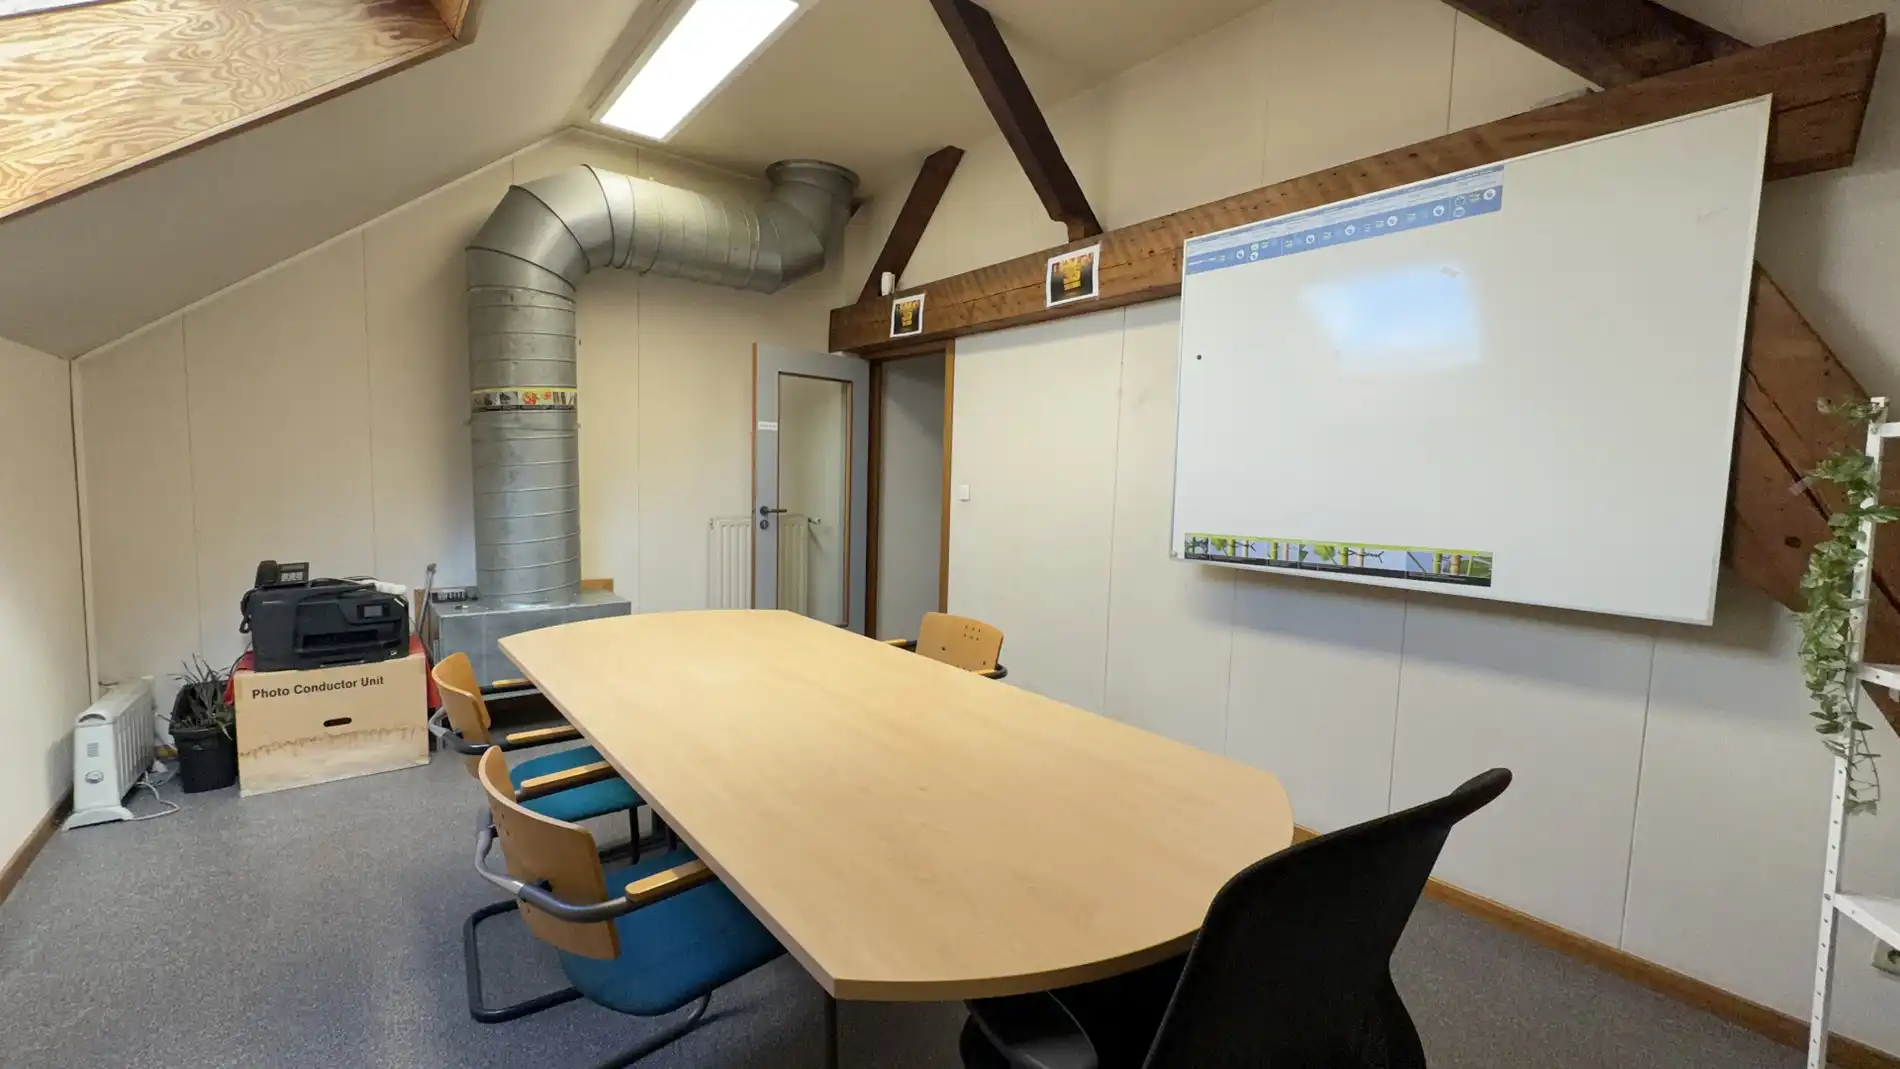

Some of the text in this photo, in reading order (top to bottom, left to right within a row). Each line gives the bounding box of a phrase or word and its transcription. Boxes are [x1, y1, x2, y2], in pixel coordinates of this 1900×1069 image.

[252, 675, 384, 699] Photo Conductor Unit
